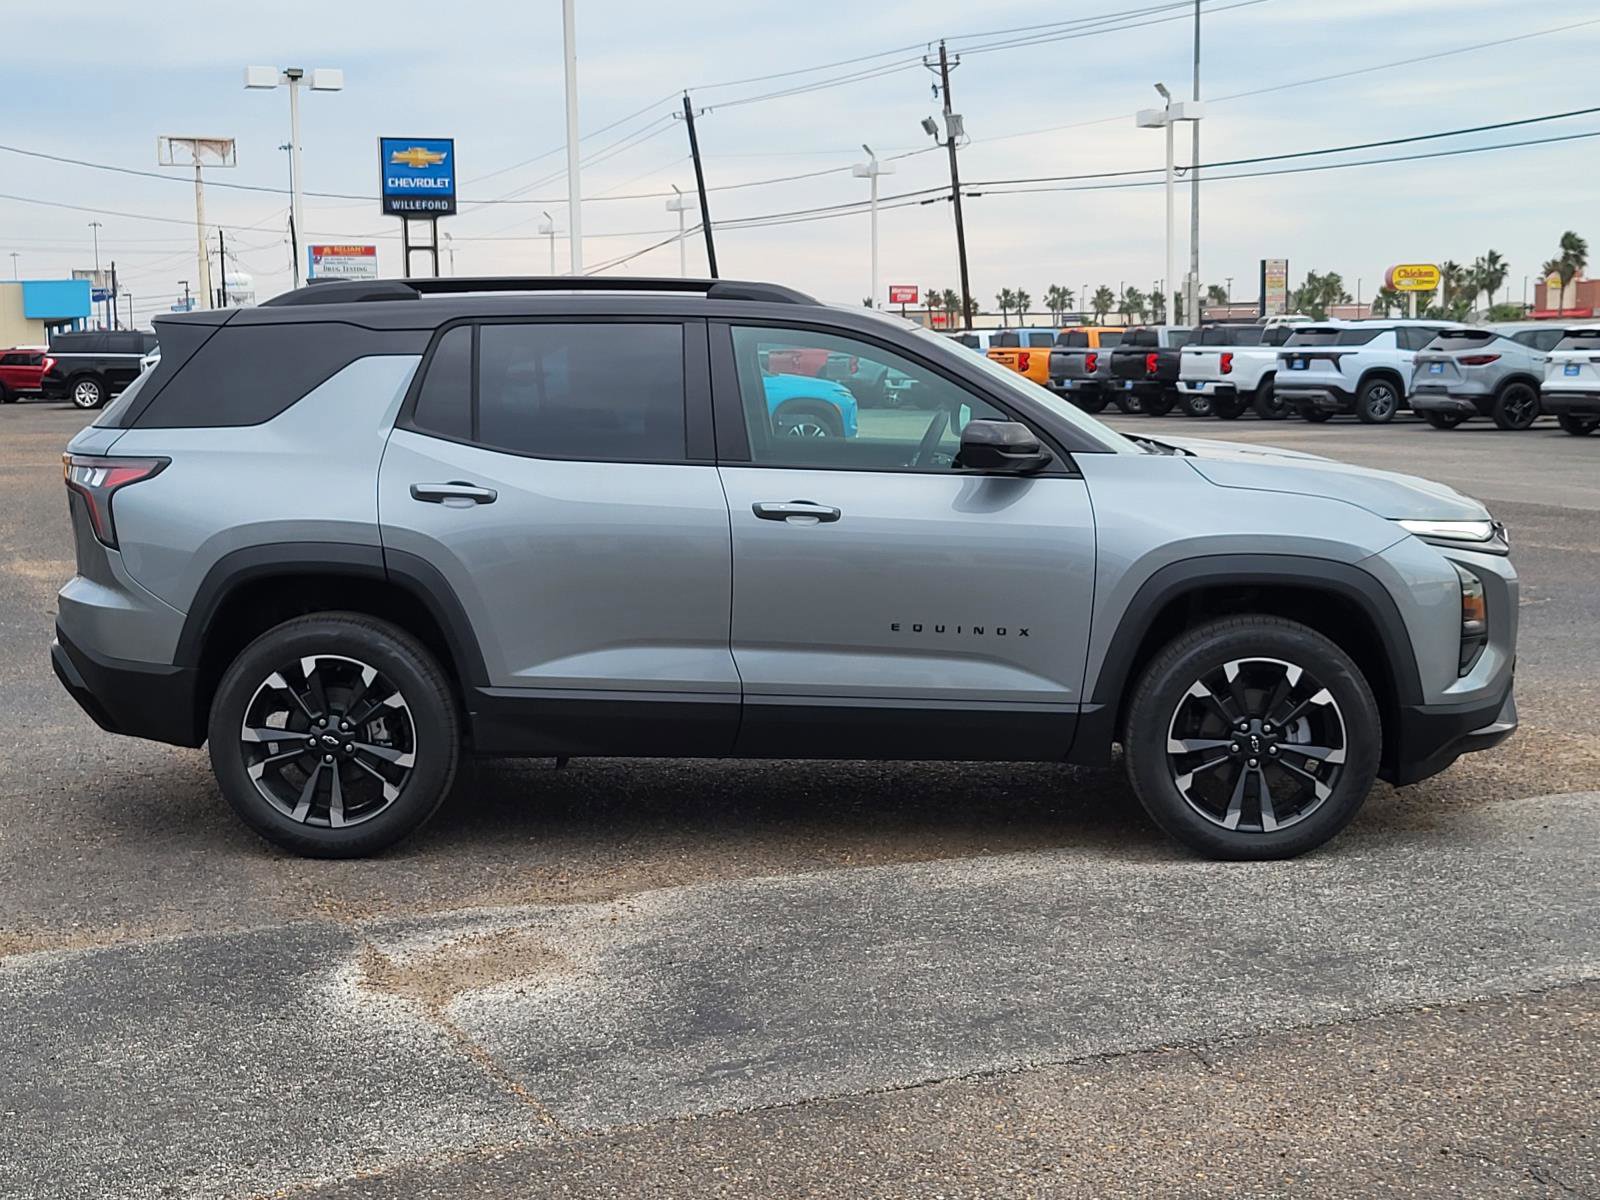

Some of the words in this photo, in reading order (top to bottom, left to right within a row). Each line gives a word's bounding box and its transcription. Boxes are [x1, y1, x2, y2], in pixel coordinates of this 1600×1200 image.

[388, 177, 450, 188] CHEVROLET
[392, 199, 449, 210] WILLEFORD
[1398, 268, 1434, 278] Chicken
[890, 622, 1030, 637] EQUINOX
